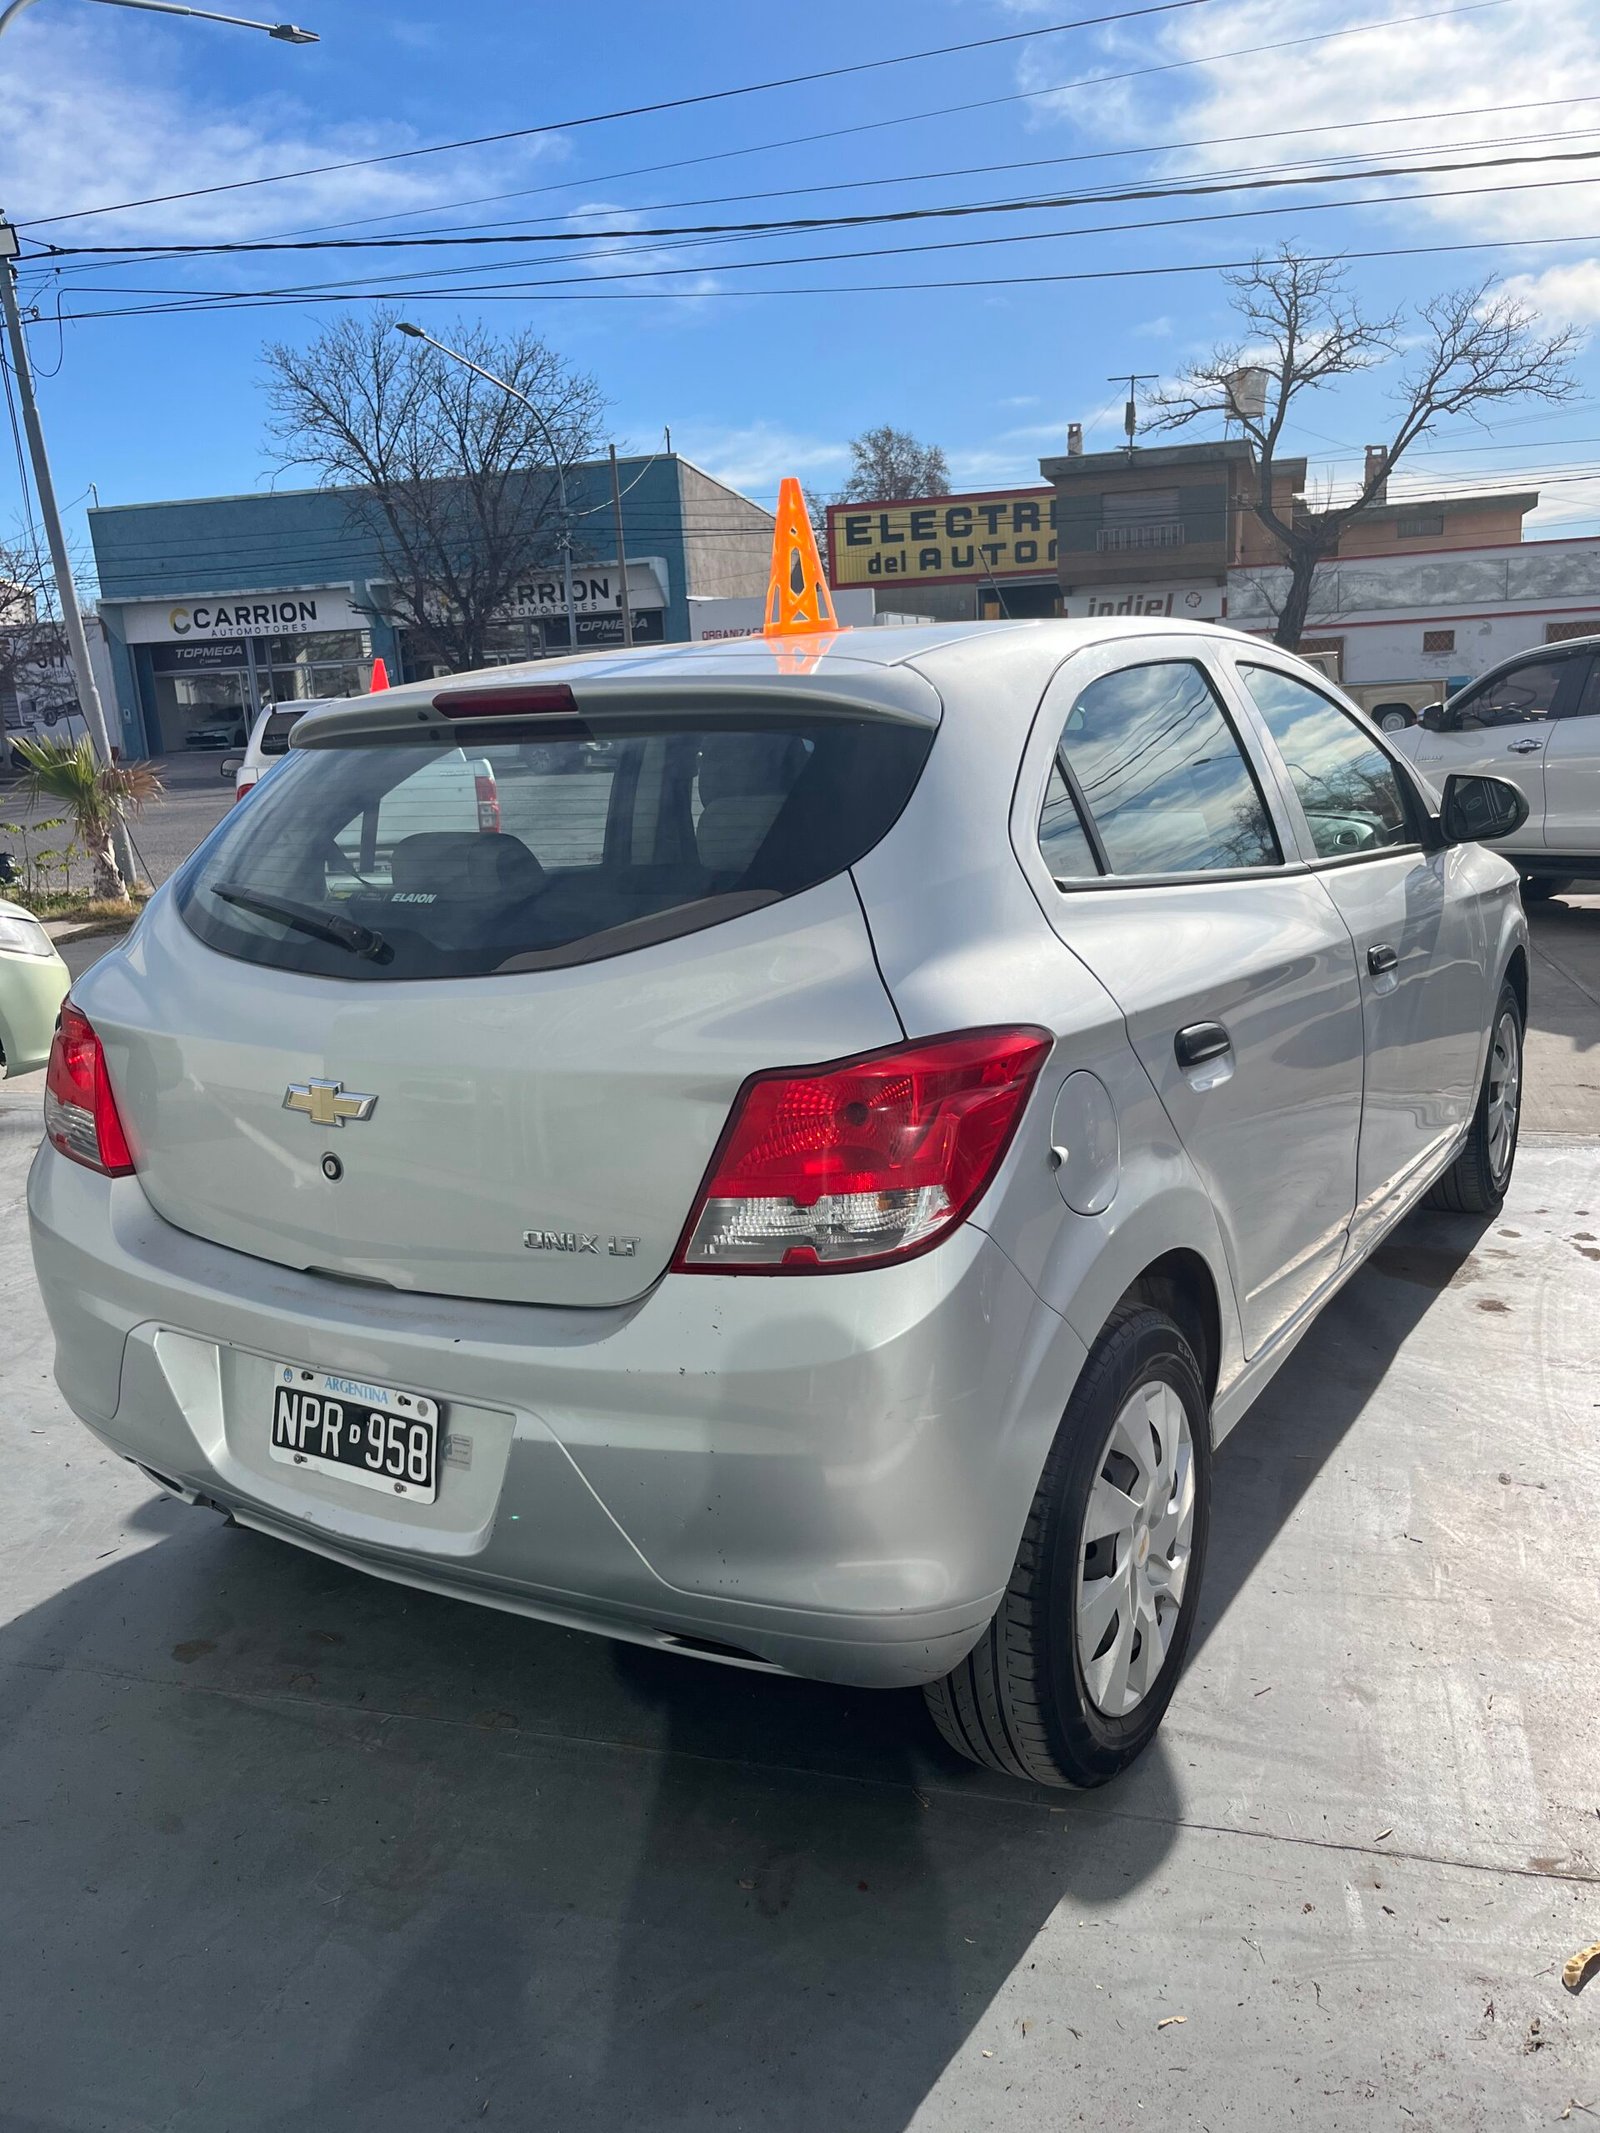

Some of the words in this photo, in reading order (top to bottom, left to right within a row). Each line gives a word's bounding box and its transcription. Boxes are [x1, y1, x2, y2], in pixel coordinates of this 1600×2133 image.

[867, 550, 906, 574] del
[193, 600, 318, 629] CARRION
[1087, 592, 1174, 617] indiel
[211, 623, 308, 637] AUTOMOTORES
[175, 645, 243, 659] TOPMEGA
[391, 892, 438, 904] ELAION
[522, 1229, 600, 1254] ONIX
[607, 1235, 641, 1257] LT
[324, 1376, 389, 1404] ARGENTINA
[276, 1390, 344, 1457] NPR
[365, 1412, 428, 1482] 958
